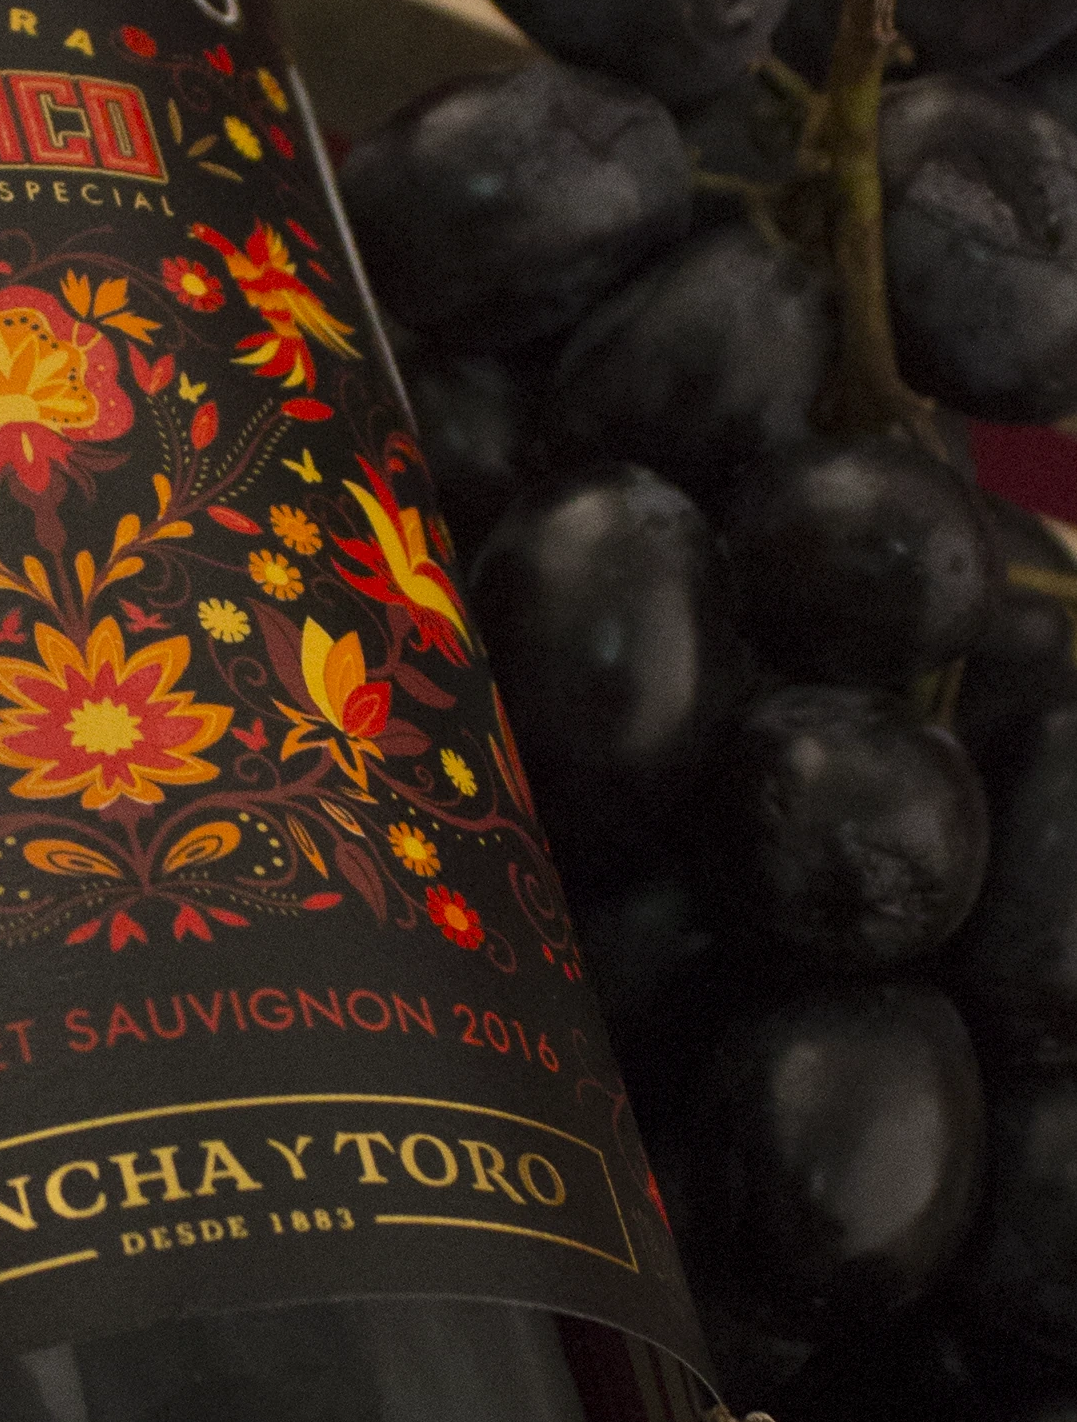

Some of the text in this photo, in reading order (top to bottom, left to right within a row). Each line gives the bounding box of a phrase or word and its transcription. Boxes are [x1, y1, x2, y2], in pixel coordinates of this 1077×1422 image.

[65, 987, 438, 1054] SAUVIGNON
[453, 1003, 561, 1073] 2016
[268, 1136, 312, 1180] Y
[334, 1131, 567, 1207] TORO
[122, 1207, 356, 1256] DESDE 1883
